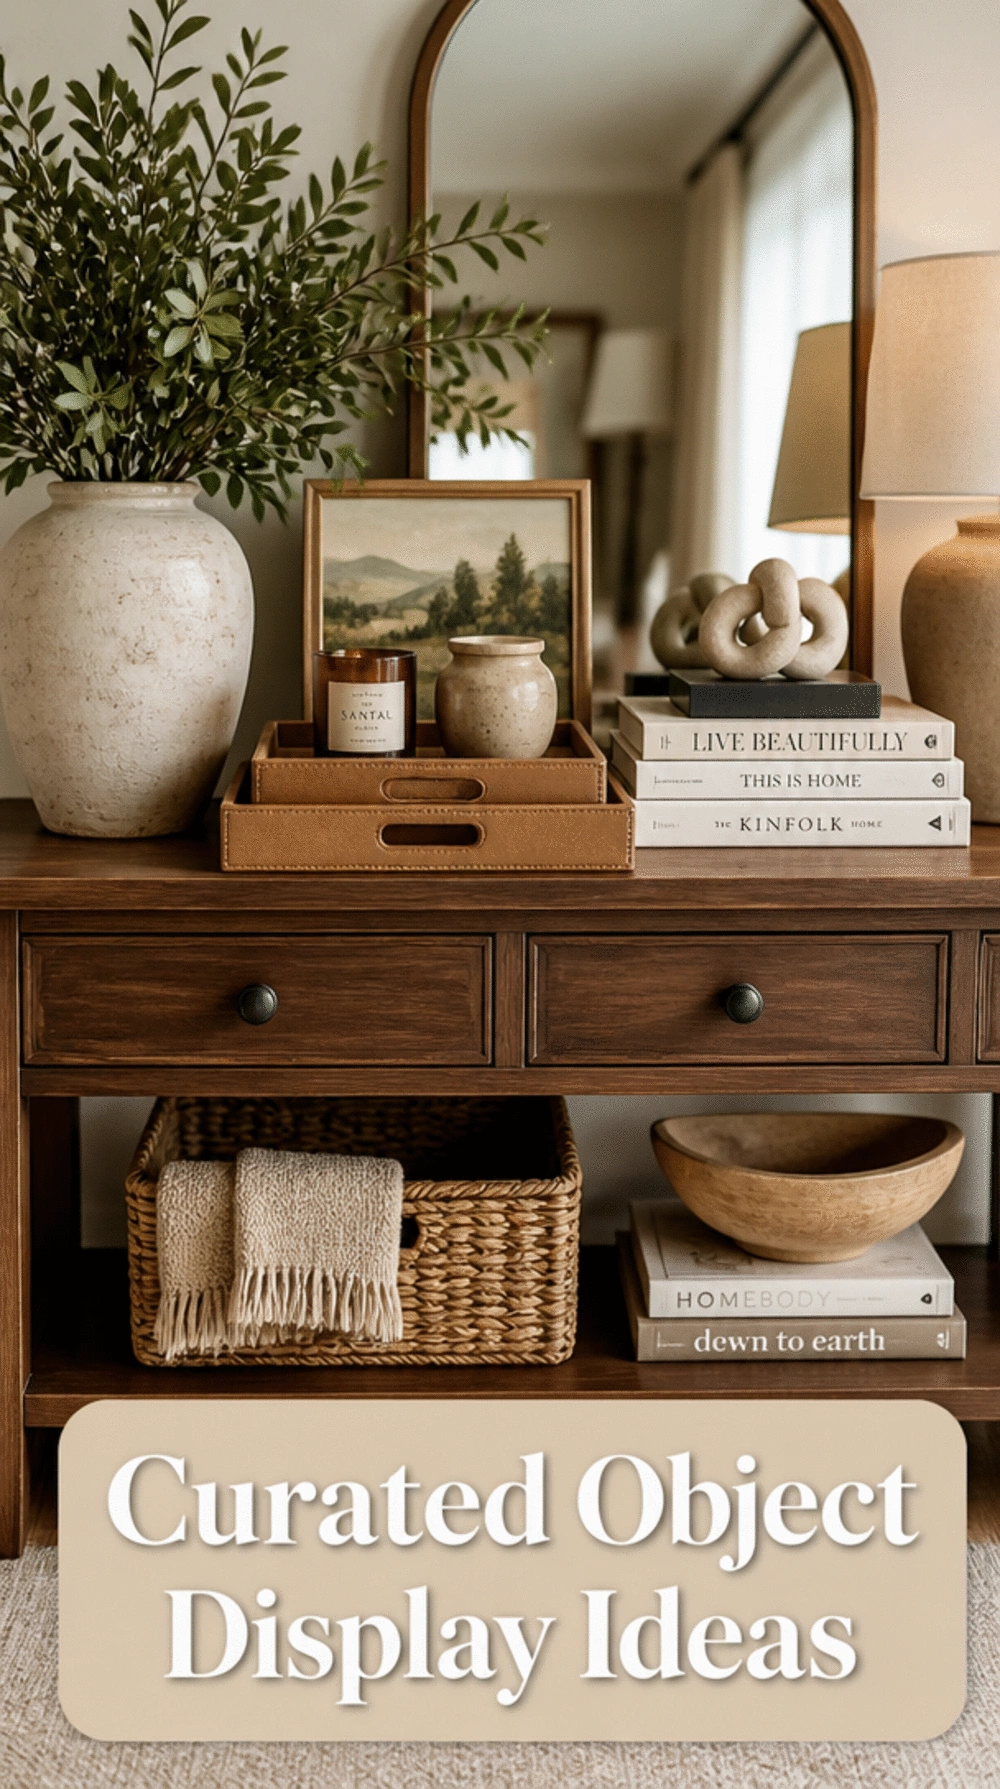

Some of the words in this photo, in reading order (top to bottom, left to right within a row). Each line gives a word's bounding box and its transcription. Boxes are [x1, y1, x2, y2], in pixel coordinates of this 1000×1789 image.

[341, 710, 393, 721] SANTAL
[692, 732, 744, 752] LIVE
[752, 732, 908, 752] BEAUTIFULLY
[740, 773, 782, 788] THIS
[787, 773, 802, 788] IS
[808, 773, 862, 788] HOME
[739, 817, 843, 832] KINFOLK
[851, 820, 883, 828] HOME
[676, 1291, 831, 1309] HOMEBODY
[776, 1332, 804, 1352] to
[812, 1328, 885, 1352] earth
